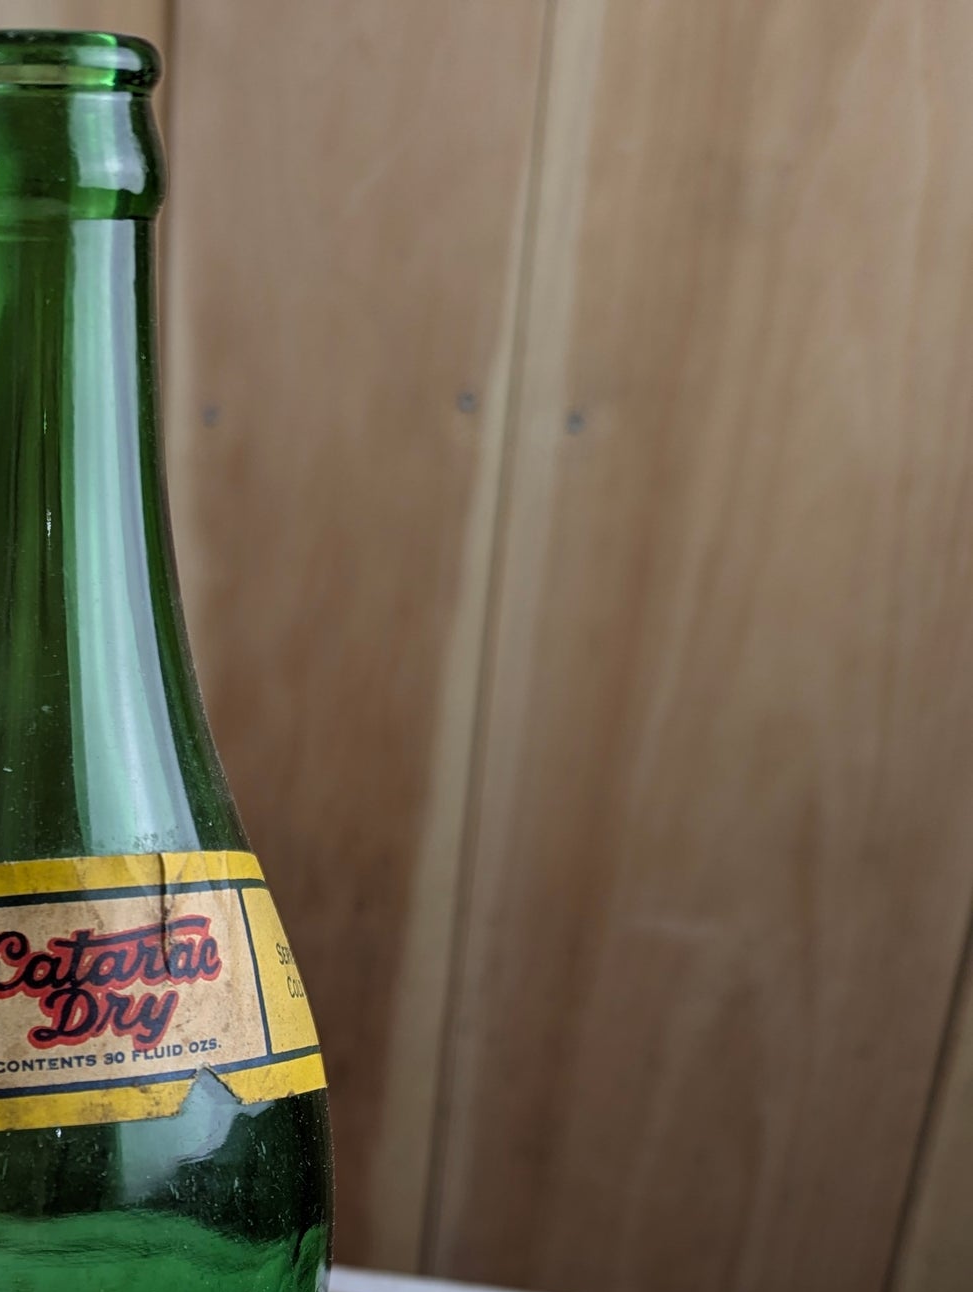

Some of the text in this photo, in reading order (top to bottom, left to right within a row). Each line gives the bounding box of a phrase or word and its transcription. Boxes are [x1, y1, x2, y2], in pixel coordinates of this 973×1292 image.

[27, 989, 179, 1050] Dry
[103, 1051, 125, 1065] 30
[132, 1043, 183, 1062] FLUID
[189, 1038, 222, 1053] OZS.
